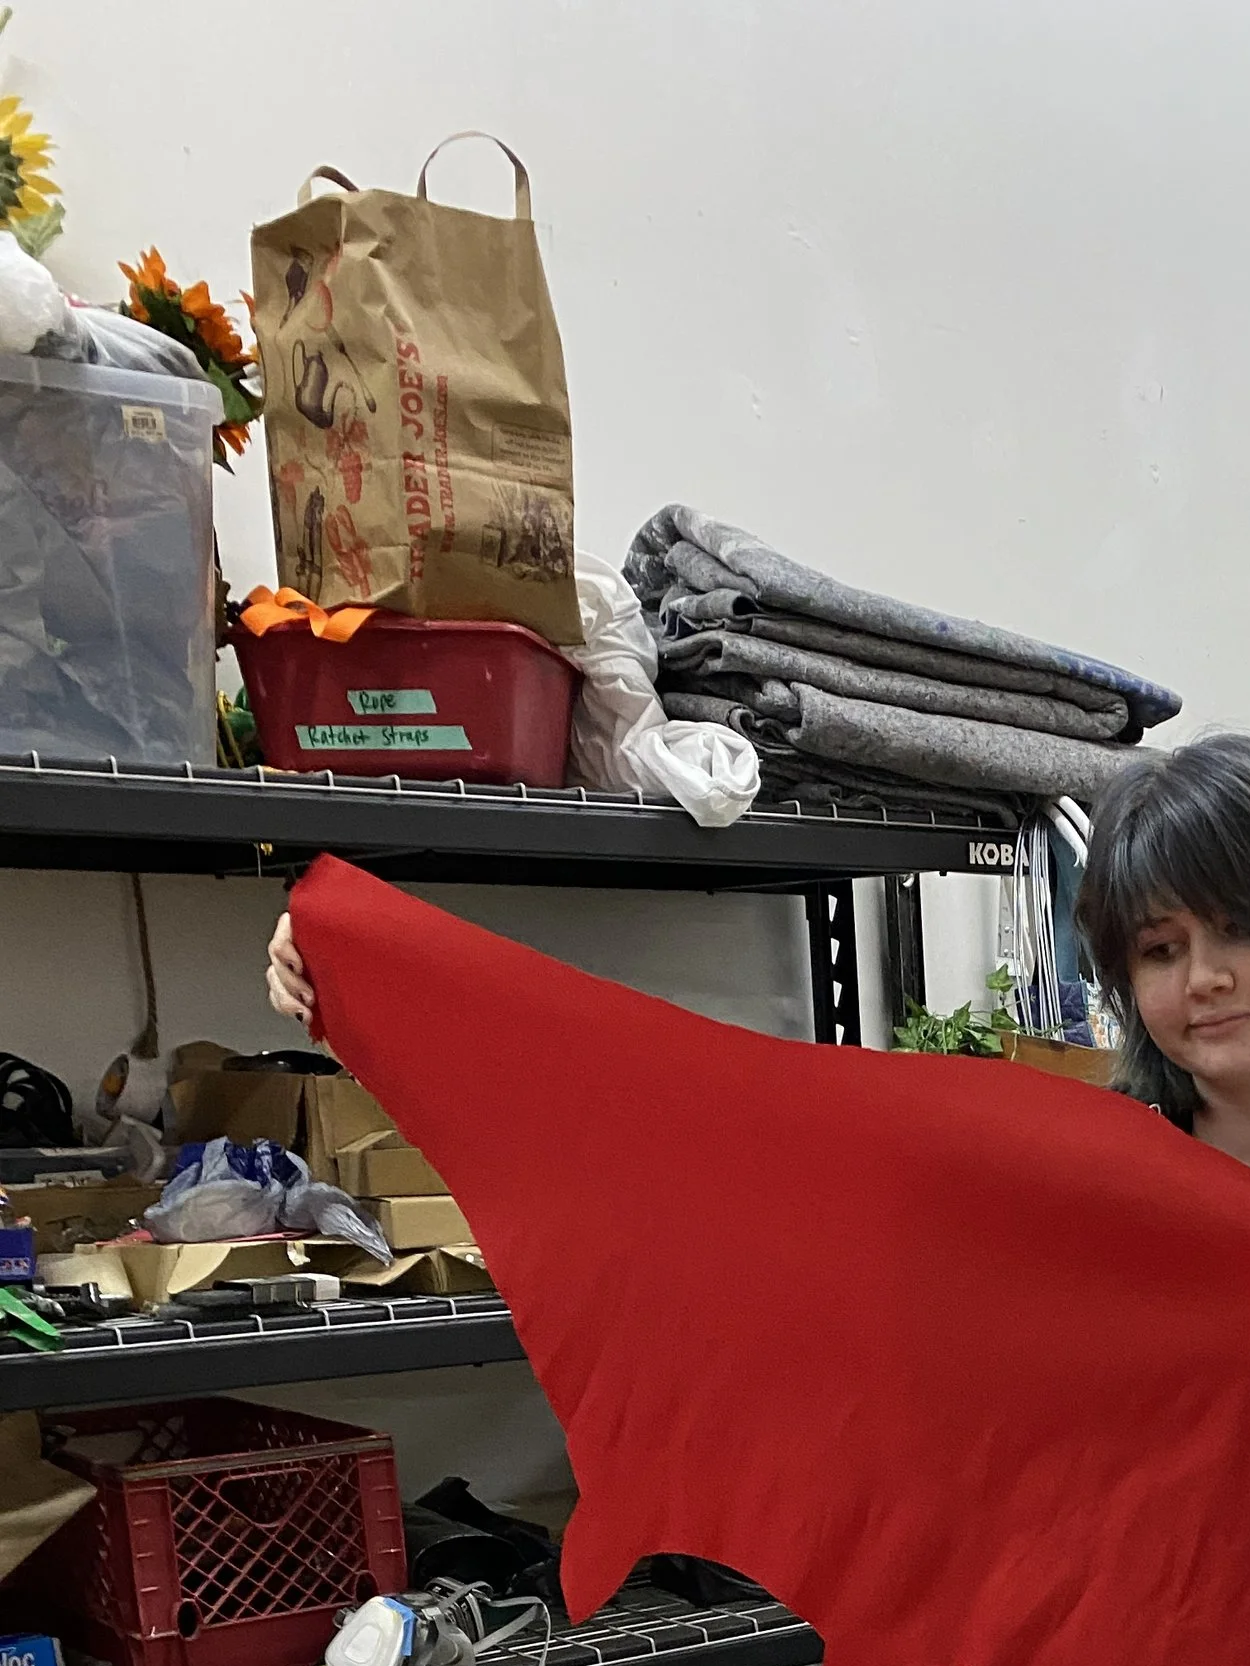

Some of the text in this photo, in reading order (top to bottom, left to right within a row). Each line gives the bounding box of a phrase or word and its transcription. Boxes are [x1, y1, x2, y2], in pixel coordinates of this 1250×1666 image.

[397, 338, 431, 580] TRADER JOE'S
[359, 691, 396, 713] Rope
[308, 725, 429, 747] Ratchet Straps
